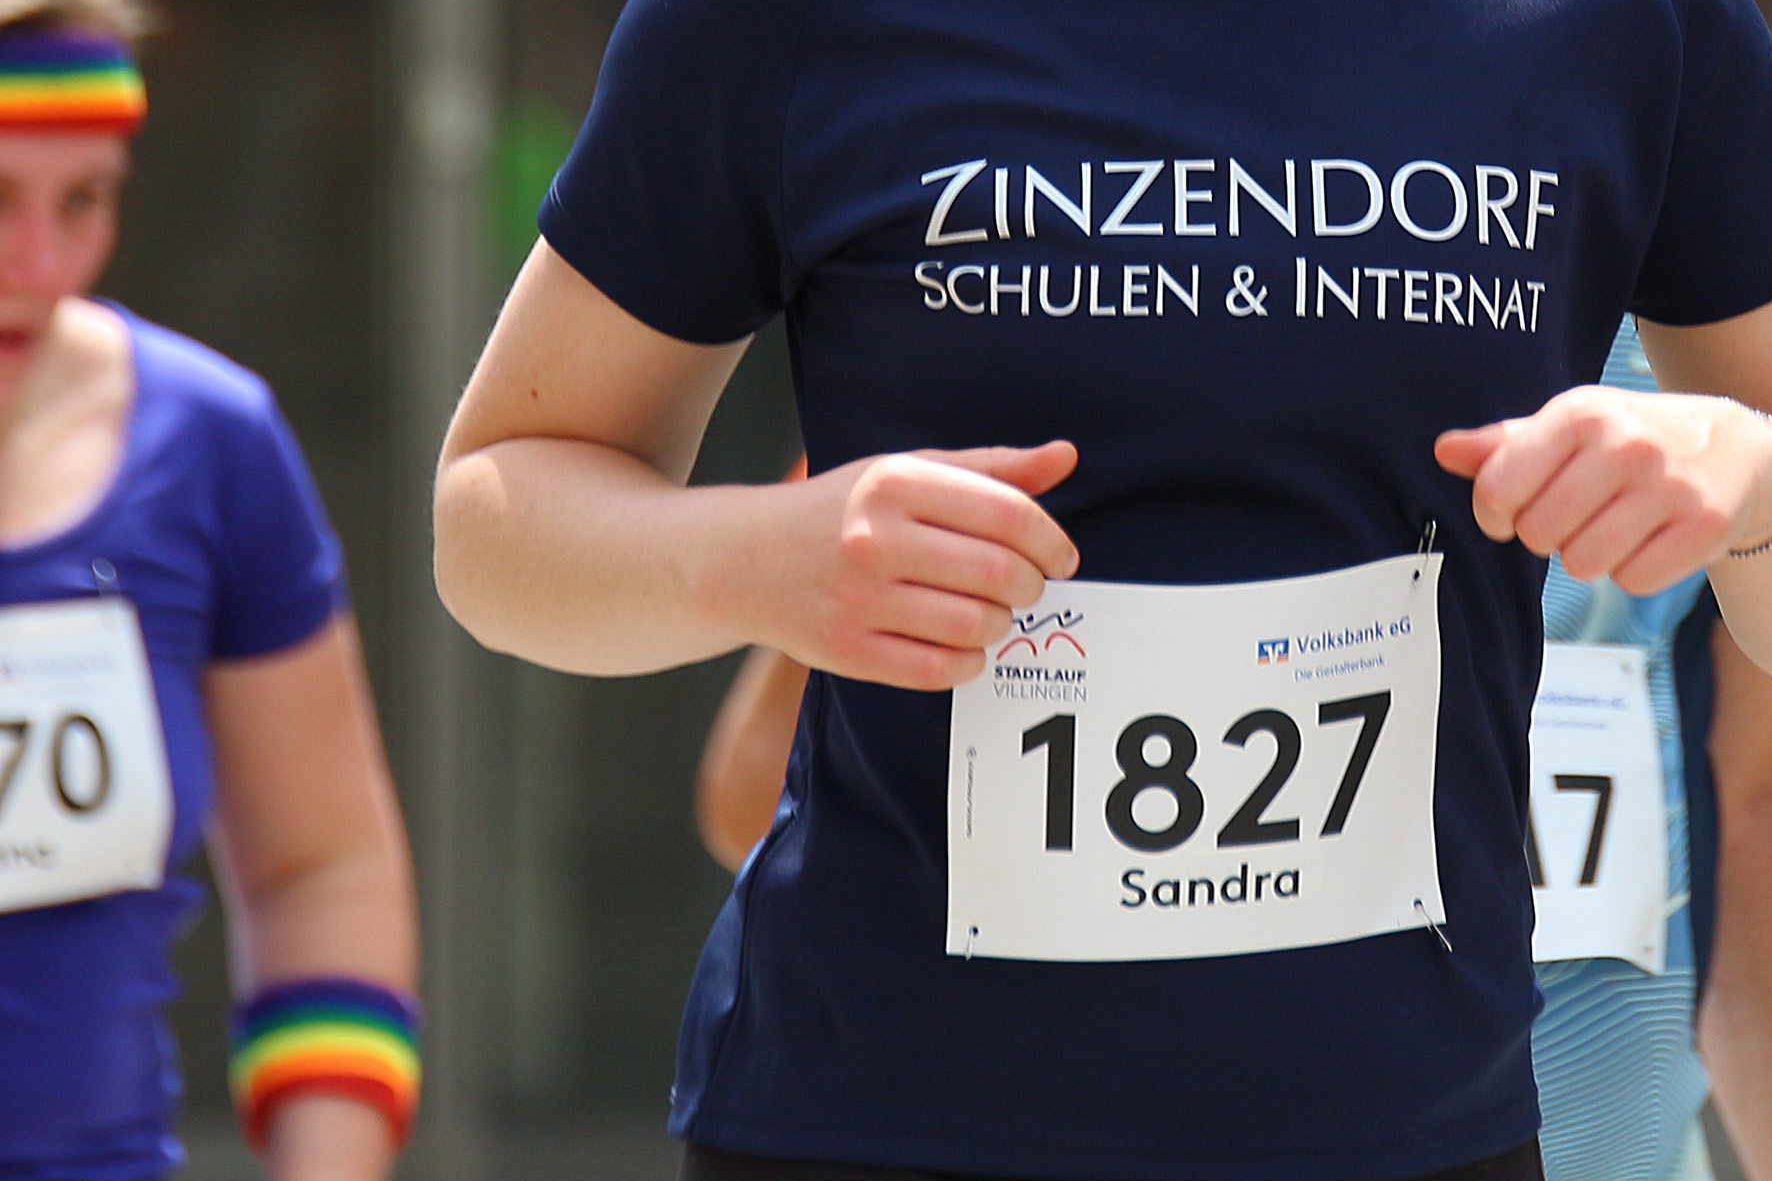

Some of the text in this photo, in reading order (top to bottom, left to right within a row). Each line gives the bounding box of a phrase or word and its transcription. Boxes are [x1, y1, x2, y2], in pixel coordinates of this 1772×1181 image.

[920, 157, 1560, 251] ZINZENDORF
[913, 256, 1547, 333] SCHULEN & INTERNAT
[1296, 615, 1412, 655] Volksbank eG
[993, 681, 1087, 703] VILLINGEN
[994, 665, 1087, 684] STADTLAUF
[1020, 688, 1393, 854] 1827
[1119, 861, 1301, 909] Sandra
